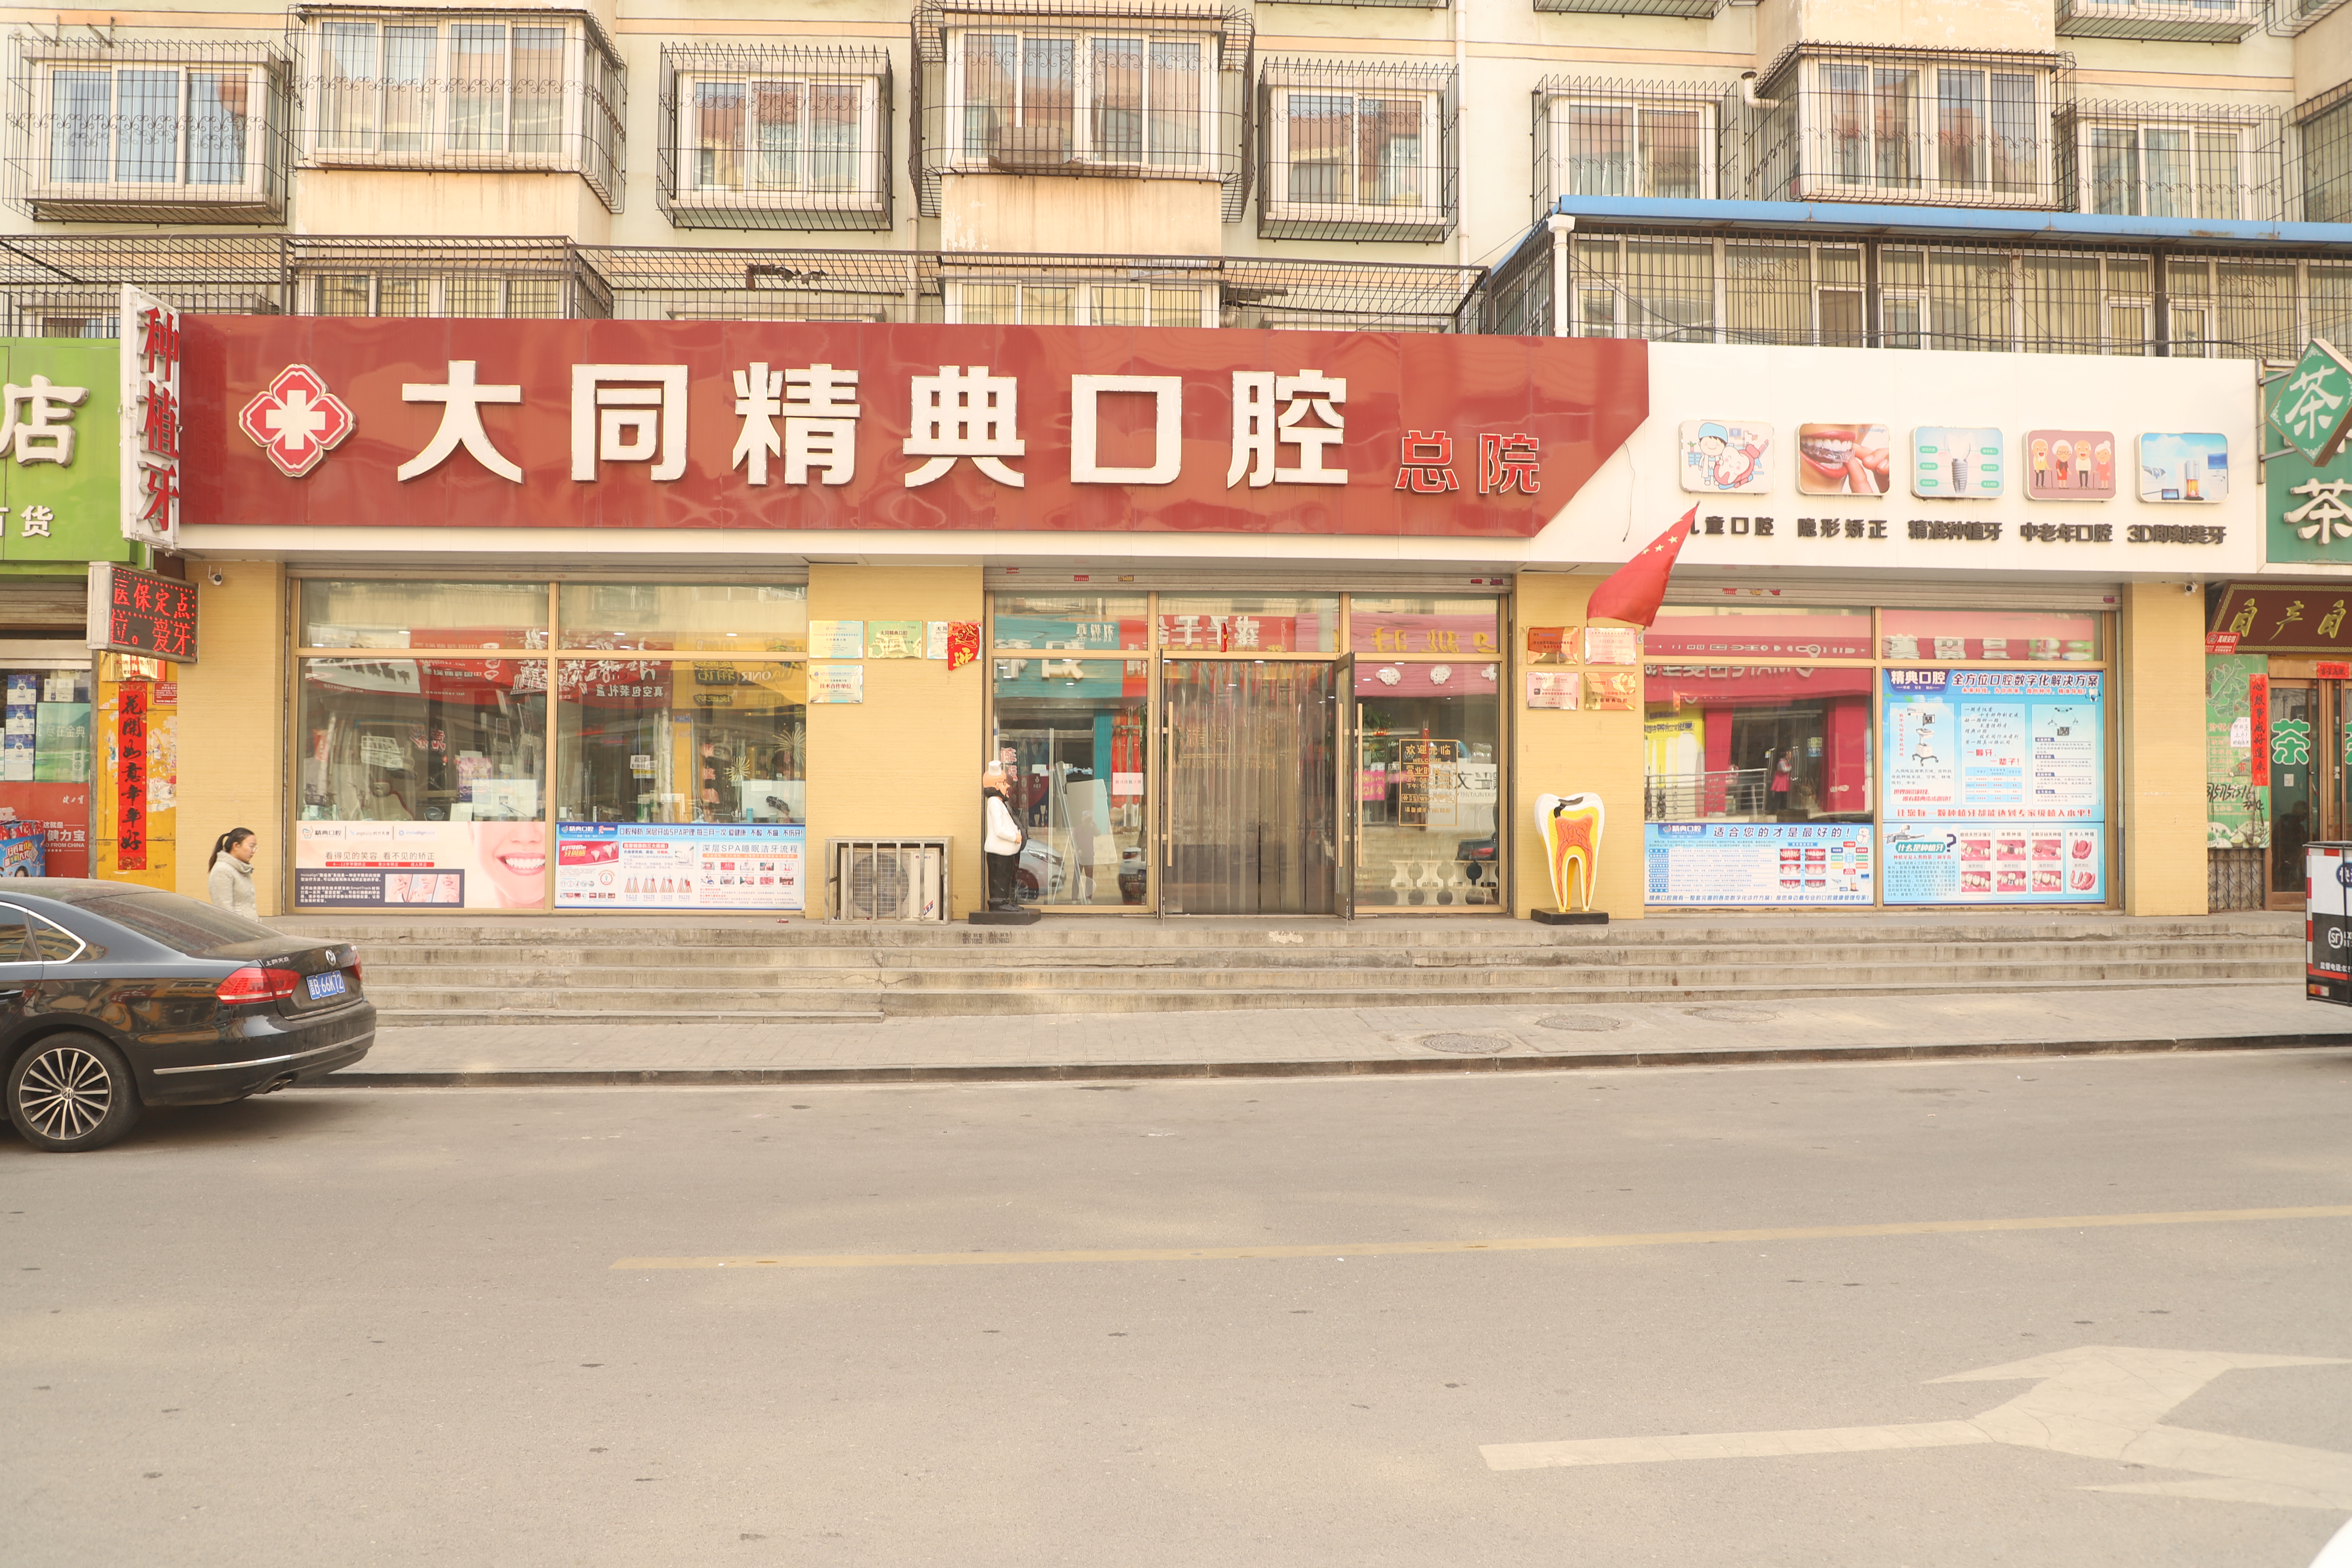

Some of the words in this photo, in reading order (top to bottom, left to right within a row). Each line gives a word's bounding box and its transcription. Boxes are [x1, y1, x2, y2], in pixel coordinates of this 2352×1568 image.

[2285, 365, 2344, 439] 茶
[0, 375, 89, 467] 店
[141, 306, 180, 531] 种植牙
[397, 360, 1349, 489] 大同精典口腔
[1395, 430, 1541, 493] 总院
[2284, 478, 2352, 544] 茶
[1797, 518, 1888, 538] 隐形矫正
[1908, 520, 2003, 540] 精准种植牙
[2020, 522, 2113, 543] 中老年口腔
[2127, 524, 2226, 544] 3D即刻美牙
[114, 578, 191, 619] 医保定点
[2229, 597, 2346, 641] 自产自
[152, 618, 191, 656] 爱牙
[1891, 671, 1946, 684] 精典口腔
[1952, 672, 2099, 687] 全方位口腔数字化解决方案
[2207, 658, 2250, 717] 茶
[46, 725, 85, 738] 尽在金典
[2271, 718, 2311, 765] 茶
[1406, 744, 1451, 755] 欢迎光临
[1406, 764, 1441, 775] 营业时间
[44, 829, 85, 842] 健力宝
[1713, 826, 1850, 838] 适合您的才是最好的！
[1897, 844, 1945, 852] 什么是种植牙
[325, 851, 378, 860] 看得见的笑容
[383, 851, 435, 860] 看不见的矫正
[702, 844, 798, 853] 深层SPA睡眠洁牙流程
